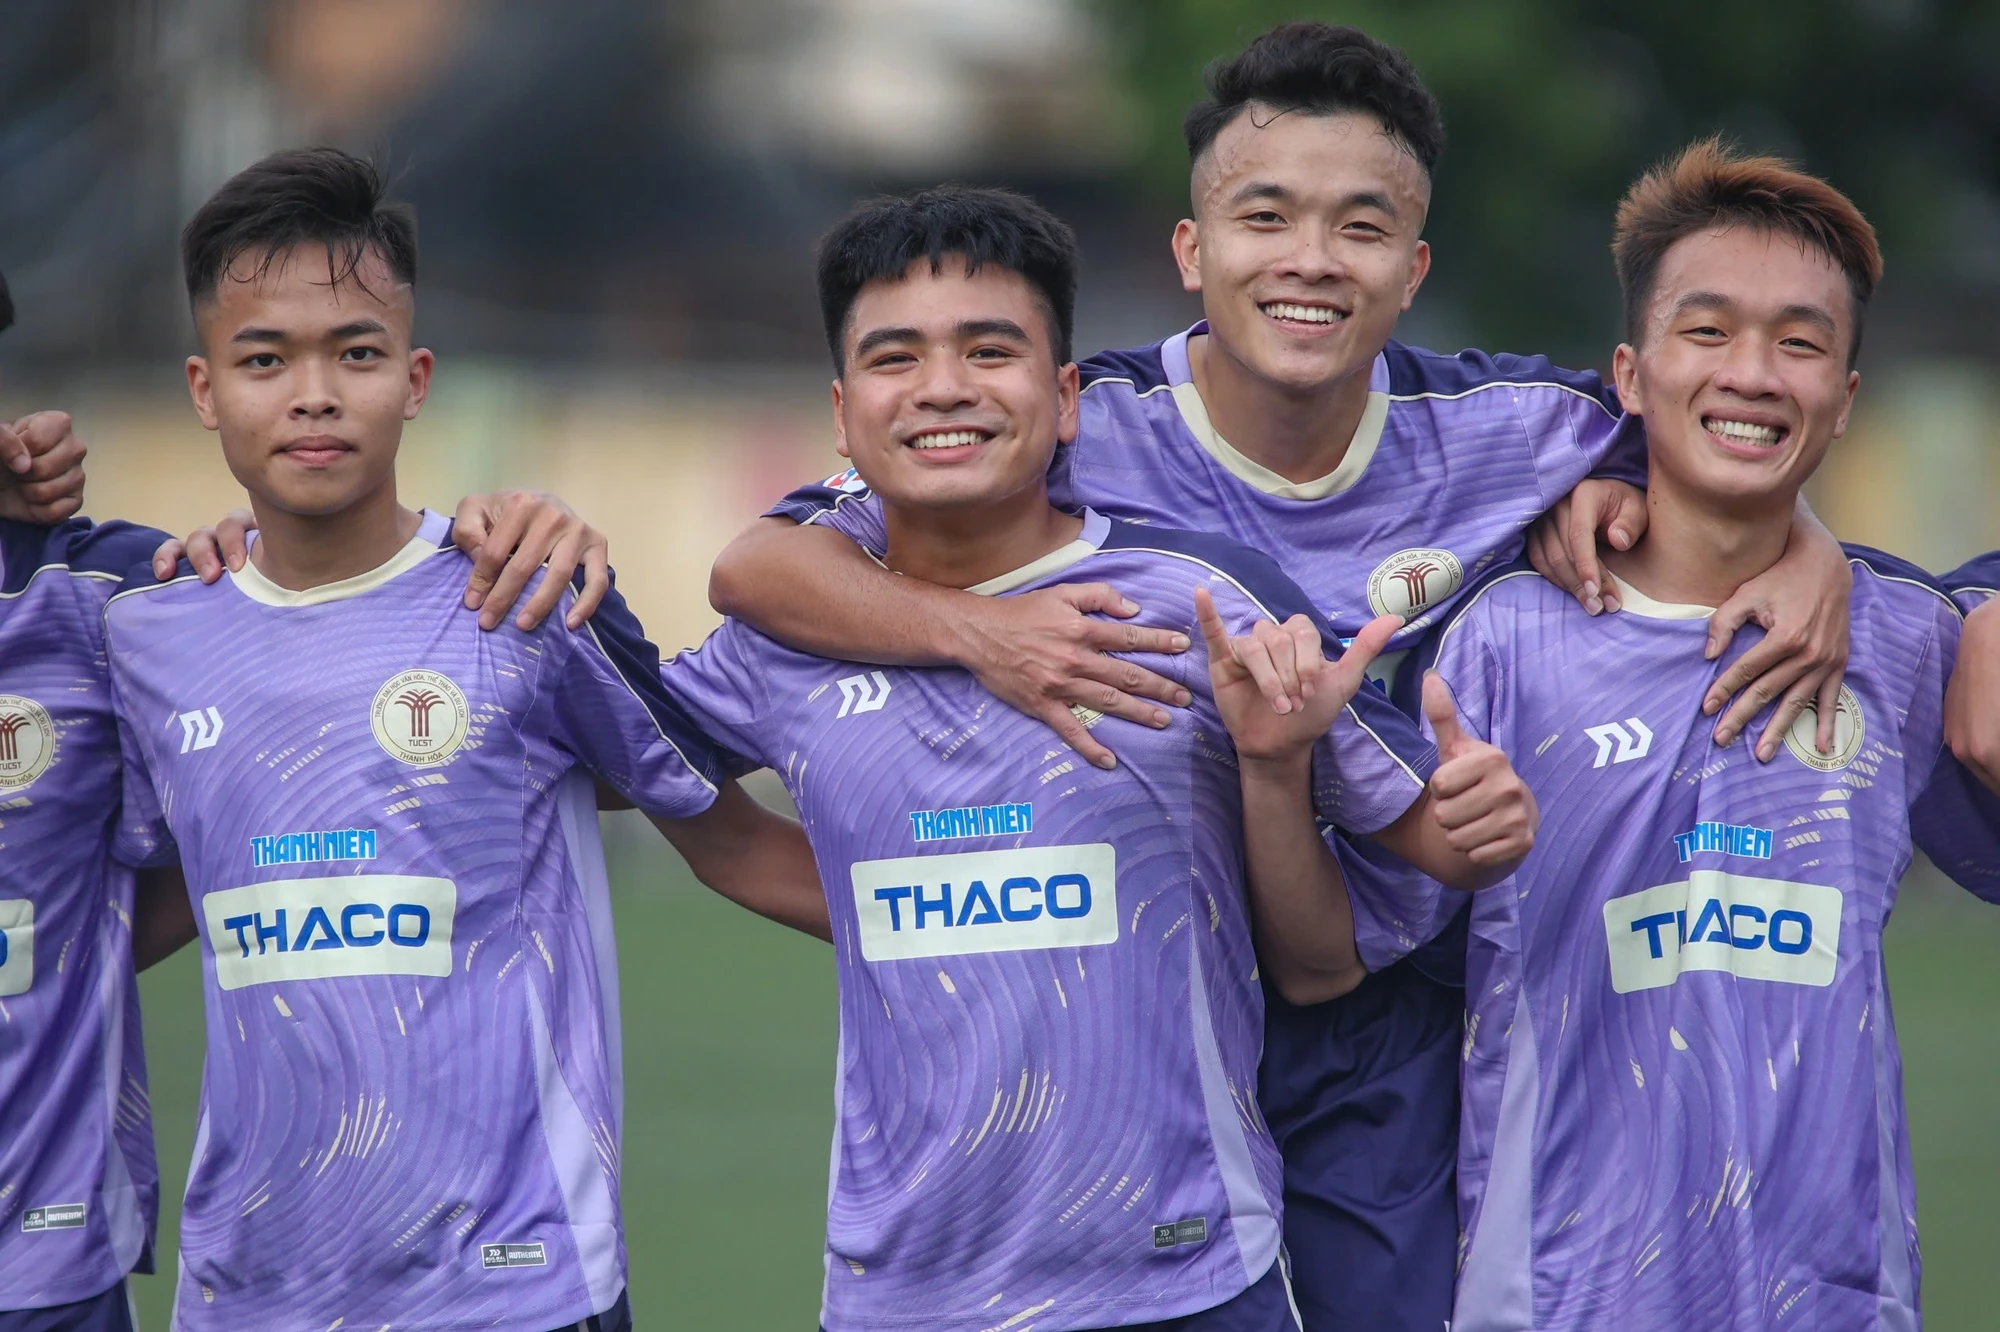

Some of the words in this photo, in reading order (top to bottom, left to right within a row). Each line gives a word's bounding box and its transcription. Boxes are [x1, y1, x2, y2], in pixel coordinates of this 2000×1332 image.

[400, 752, 425, 762] THANH
[909, 807, 980, 842] THANH
[979, 802, 1033, 838] NIÊN
[1673, 821, 1725, 863] TNH
[250, 831, 321, 867] THANH
[321, 828, 376, 861] NIÊN
[874, 873, 1092, 931] THACO
[223, 903, 431, 958] THACO
